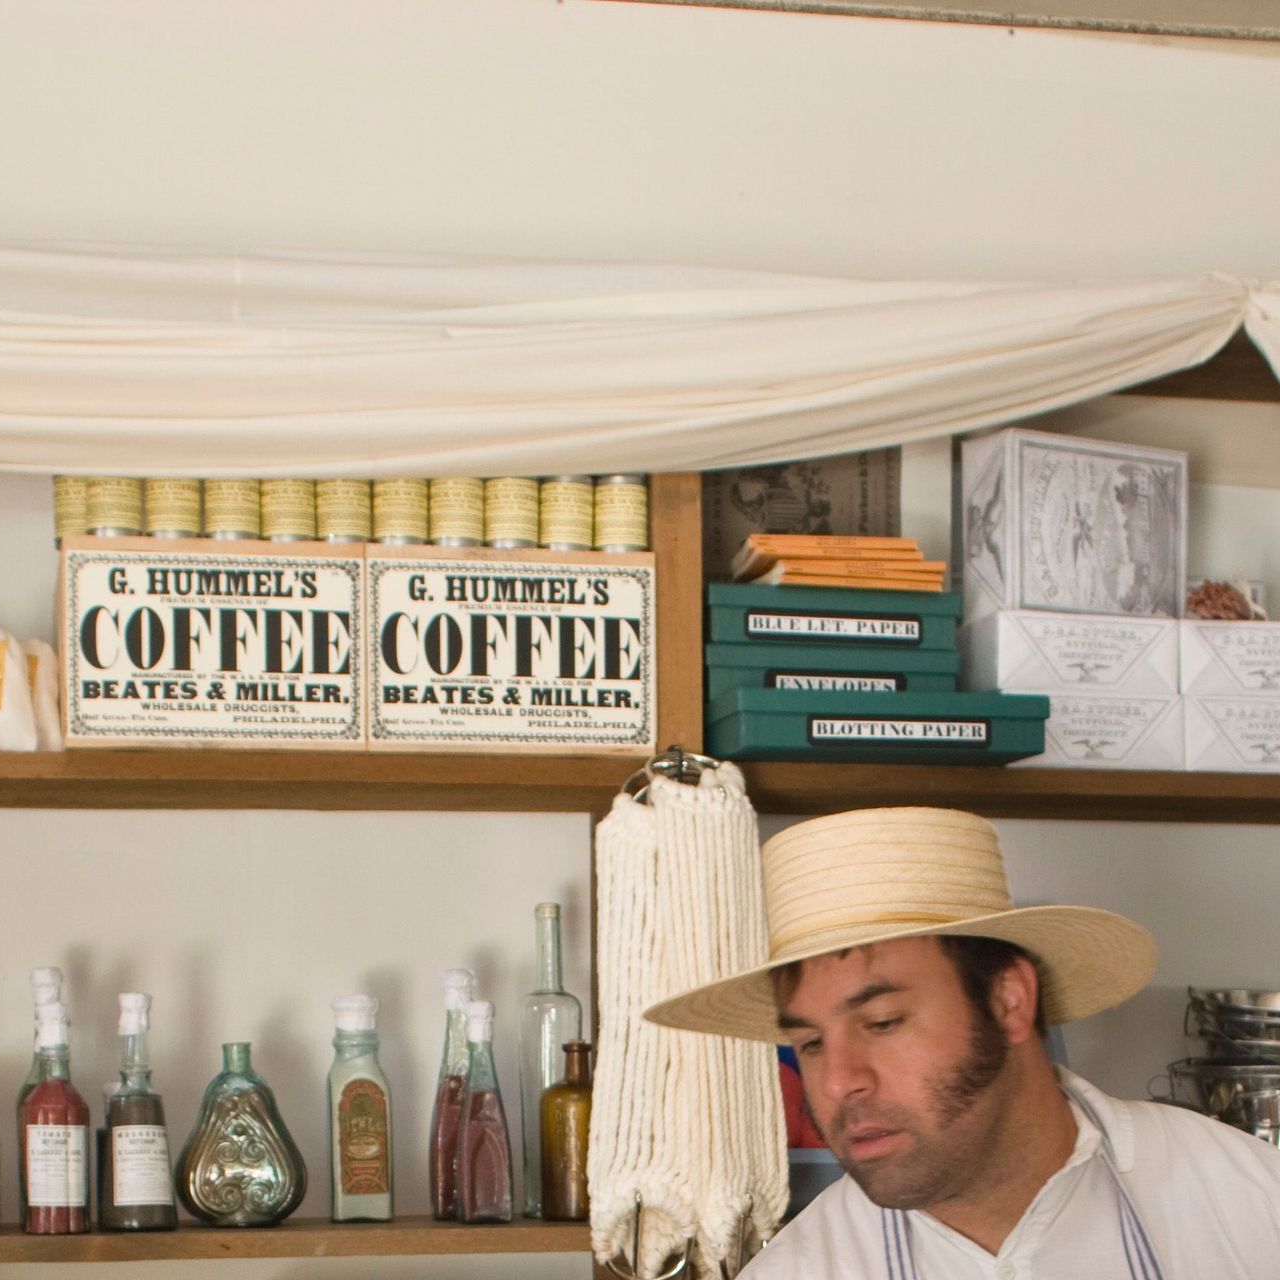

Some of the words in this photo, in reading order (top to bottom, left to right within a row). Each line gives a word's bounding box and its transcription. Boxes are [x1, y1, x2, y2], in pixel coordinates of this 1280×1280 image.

[109, 567, 135, 594] G.
[147, 567, 318, 598] HUMMEL'S
[408, 574, 434, 601] G.
[446, 575, 610, 606] HUMMEL'S
[752, 617, 801, 631] BLUE
[807, 619, 848, 632] LET.
[857, 621, 917, 636] PAPER
[80, 605, 351, 675] COFFEE
[381, 611, 641, 680] COFFEE
[81, 680, 198, 700] BEATES
[206, 681, 227, 700] &
[779, 677, 895, 691] ENVELOPES
[382, 685, 494, 704] BEATES
[501, 686, 522, 705] &
[141, 702, 217, 712] WHOLESALE
[440, 707, 513, 717] WHOLESALE
[816, 722, 914, 736] BLOTTING
[922, 724, 983, 738] PAPER
